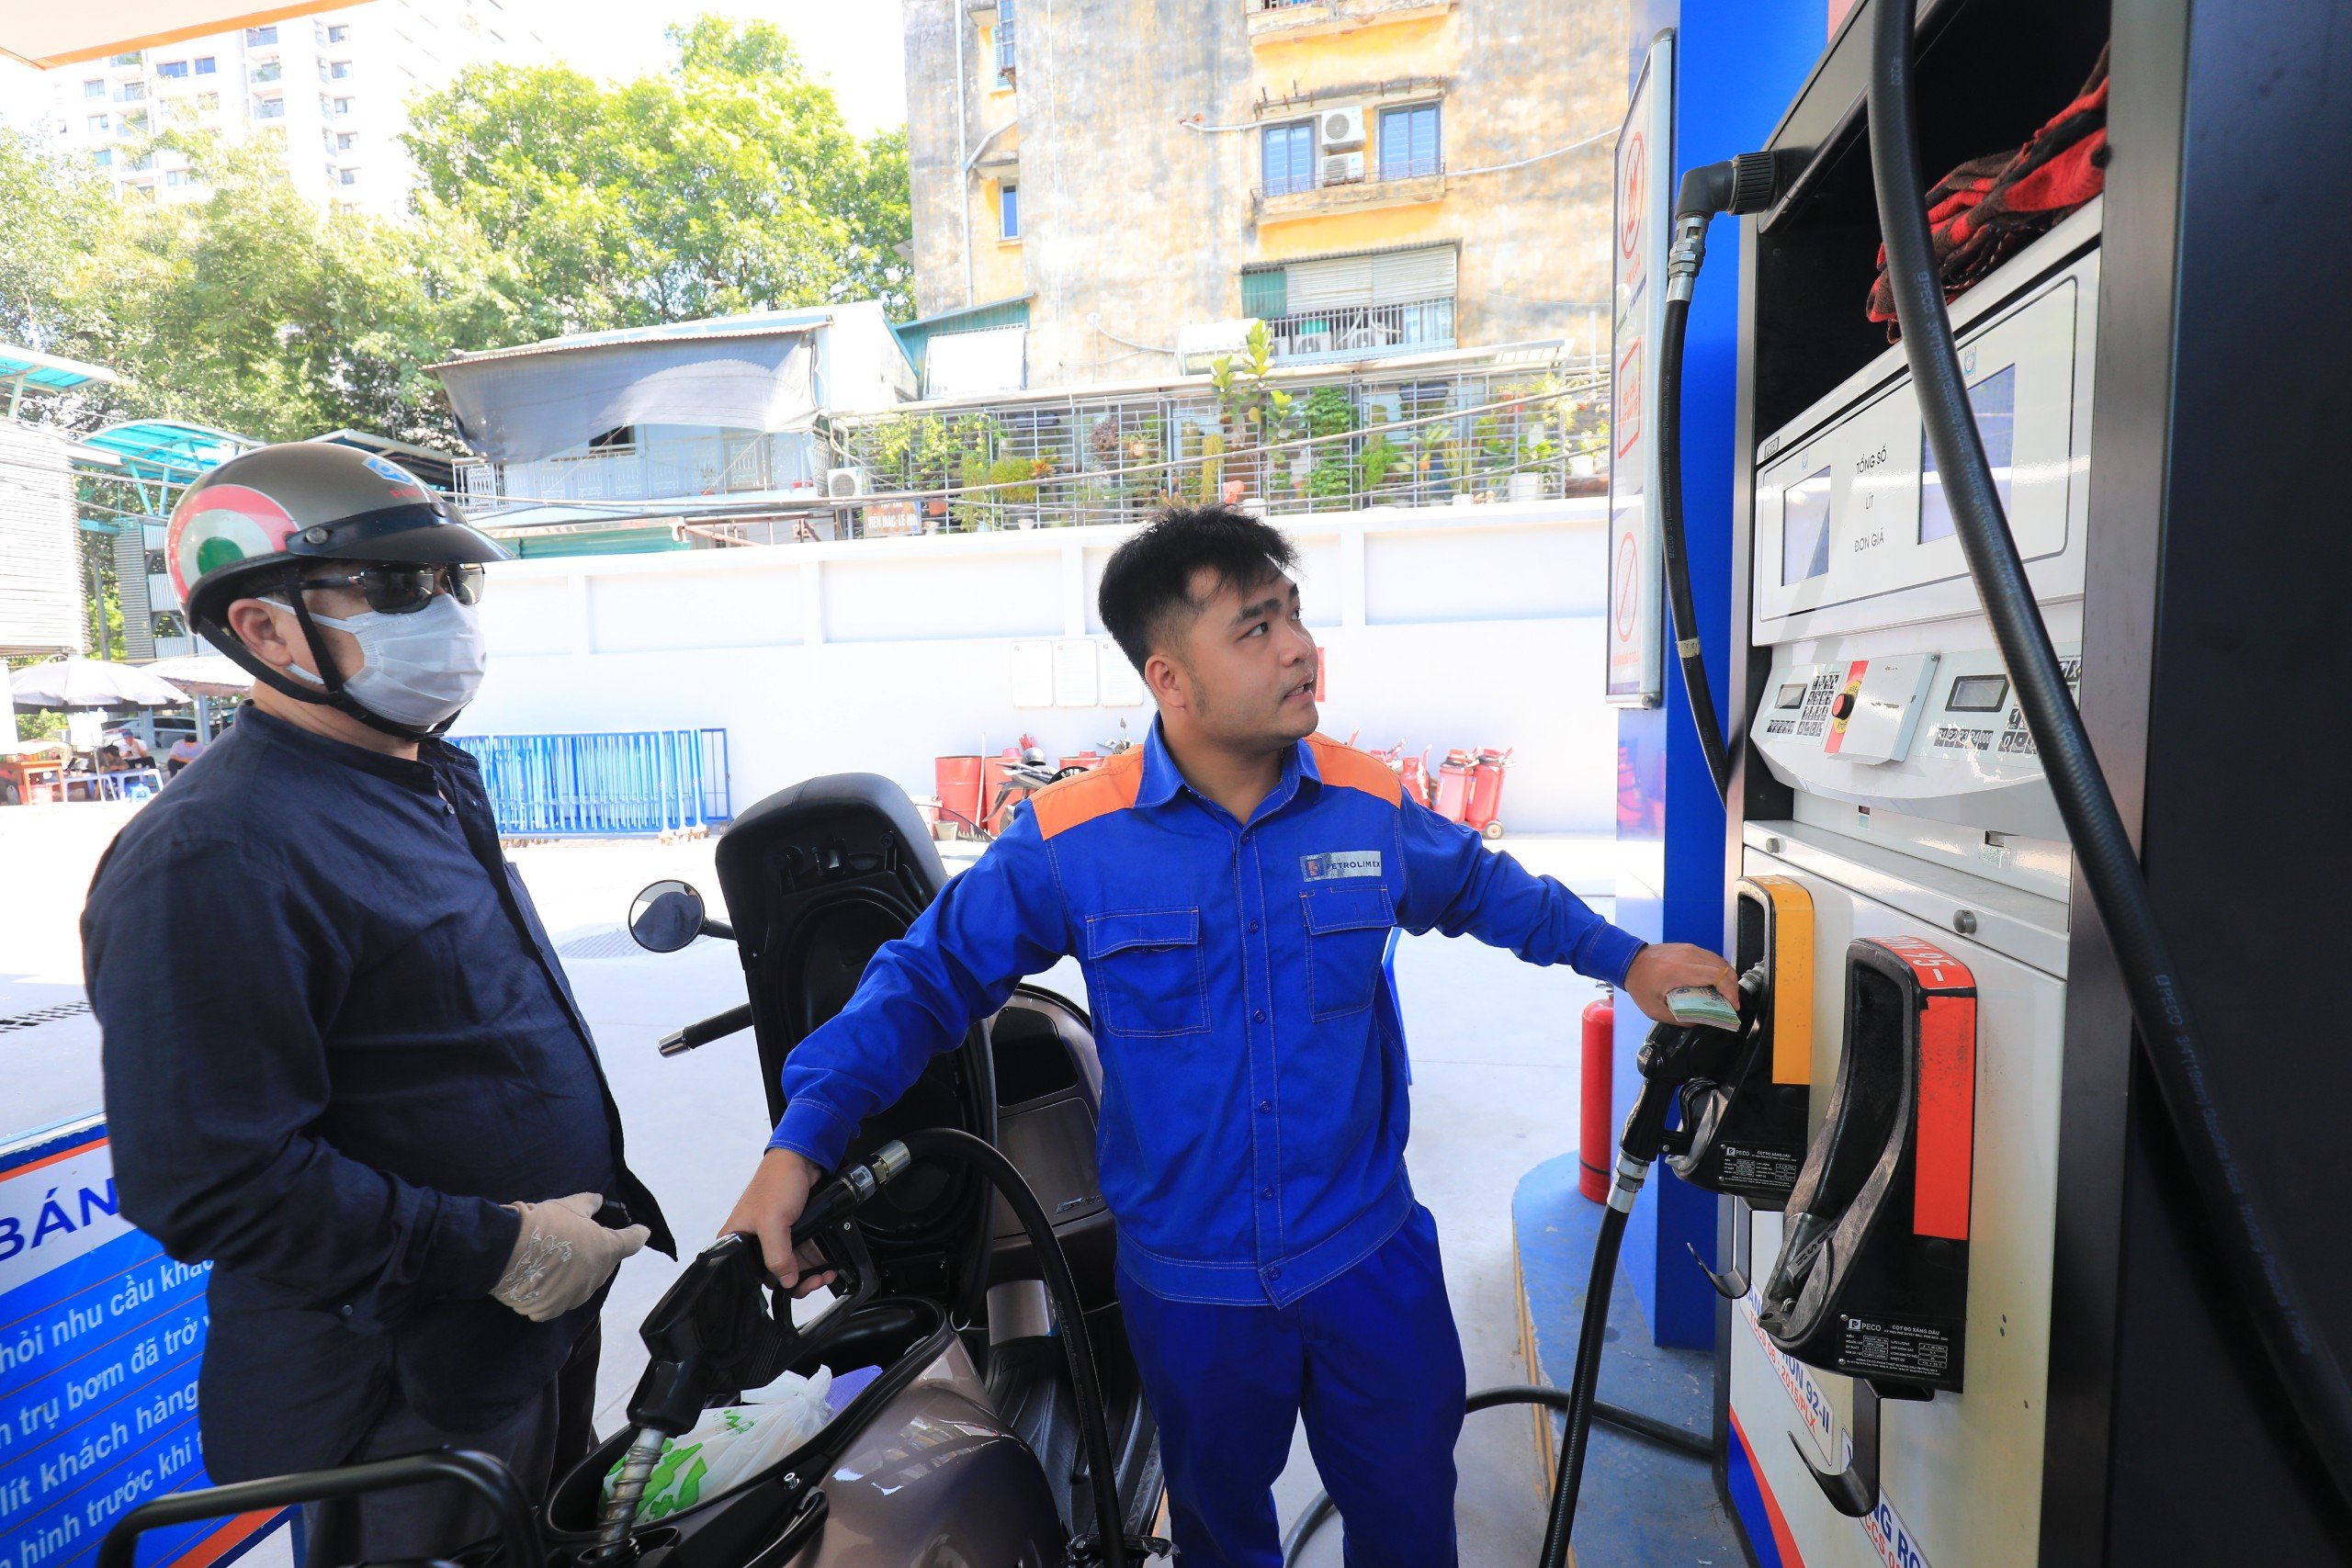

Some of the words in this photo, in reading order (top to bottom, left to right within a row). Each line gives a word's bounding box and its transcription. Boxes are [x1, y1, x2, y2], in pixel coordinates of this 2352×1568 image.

[1919, 281, 1936, 312] PECO
[1945, 381, 1963, 424] Gasoline
[1955, 426, 1971, 453] Hose
[1965, 461, 1985, 504] Working
[1856, 453, 1875, 474] TỔNG
[1876, 443, 1887, 465] SỐ
[1865, 491, 1874, 510] LÍT
[1854, 536, 1870, 552] ĐƠN
[1871, 526, 1884, 547] GIÁ
[1327, 861, 1381, 870] PETROLIMEX
[2159, 986, 2183, 1027] PECO
[0, 1177, 119, 1261] BÁN
[52, 1303, 103, 1347] nhu
[109, 1274, 154, 1316] cầu
[1861, 1323, 1882, 1332] PECO
[18, 1397, 61, 1436] trụ
[66, 1362, 125, 1411] bơm
[130, 1337, 160, 1374] đã
[164, 1316, 198, 1356] trở
[1767, 1341, 1776, 1365] 06
[1781, 1365, 1816, 1435] 2015/PLX
[1805, 1381, 1829, 1434] 92-II
[0, 1476, 32, 1517] lít
[40, 1421, 129, 1493] khách
[135, 1380, 198, 1436] hàng
[20, 1513, 81, 1568] hình
[85, 1471, 154, 1528] trước
[158, 1436, 192, 1481] khi
